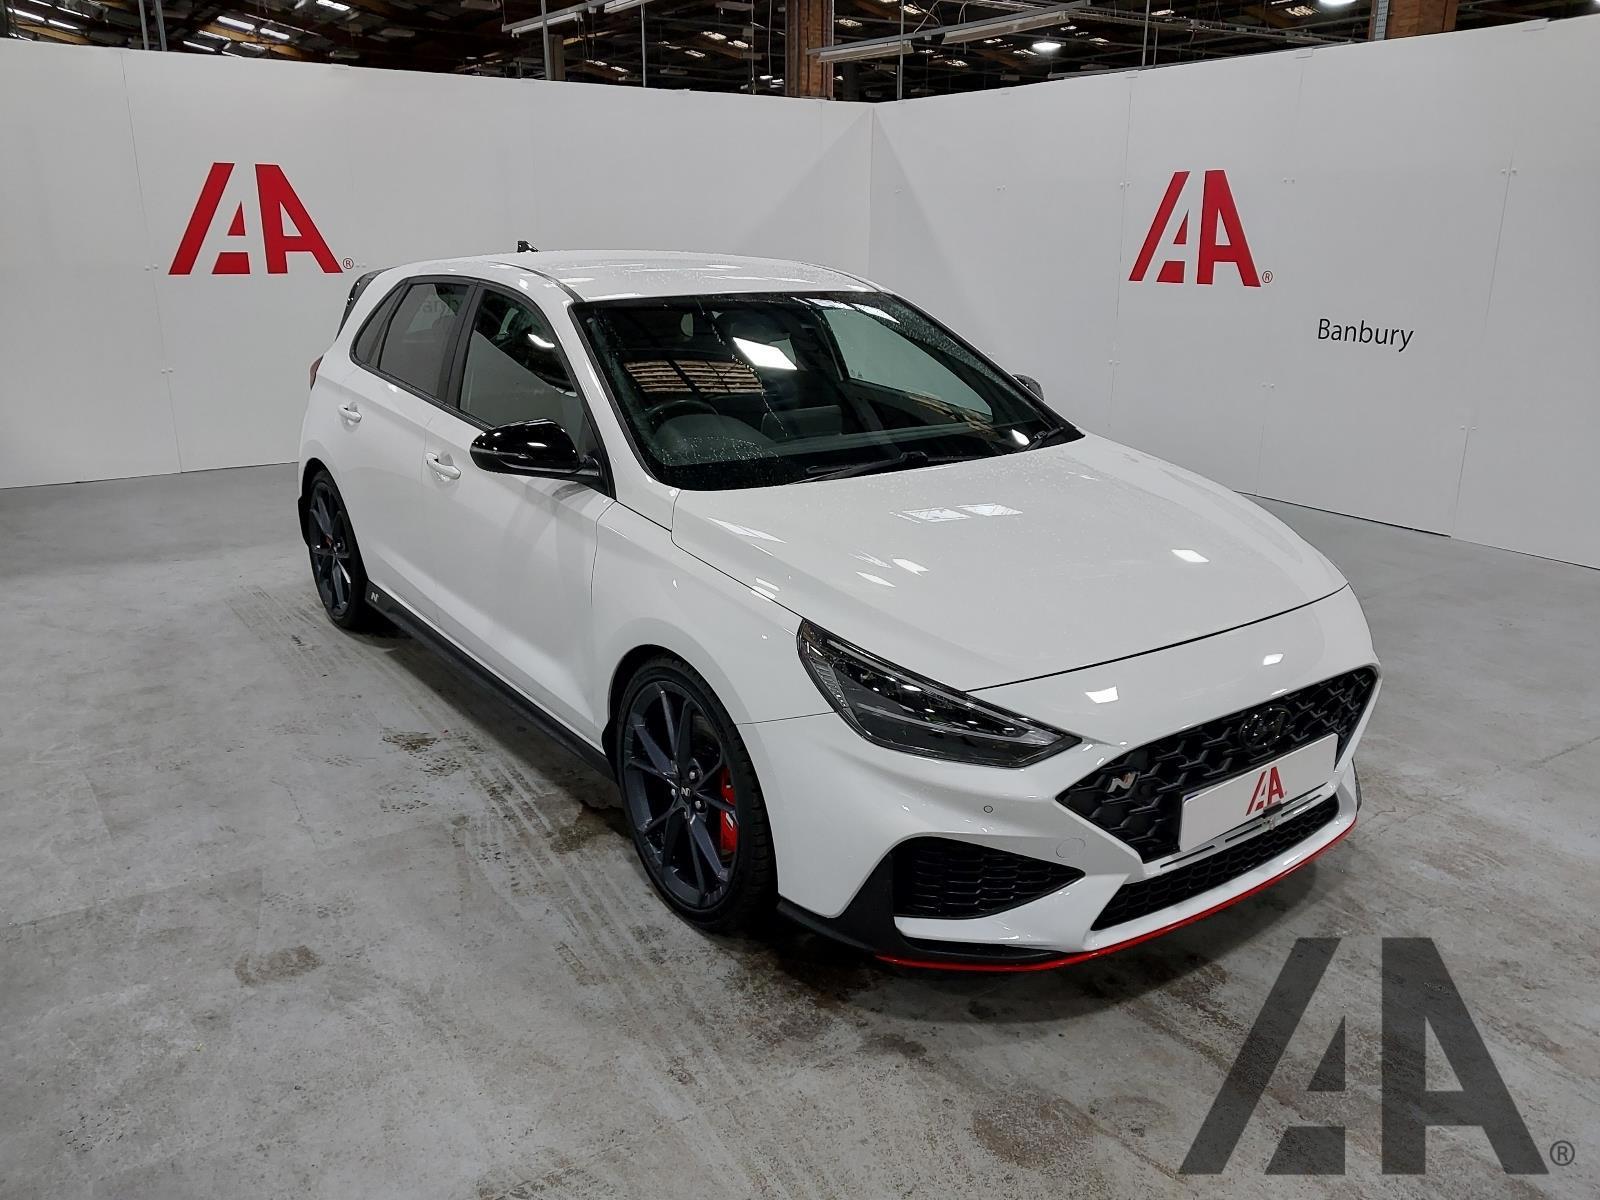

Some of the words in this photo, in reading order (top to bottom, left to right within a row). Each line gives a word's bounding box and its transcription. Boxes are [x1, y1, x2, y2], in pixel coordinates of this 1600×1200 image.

[168, 162, 344, 275] AA
[1128, 169, 1261, 287] AA
[1317, 317, 1415, 353] Banbury
